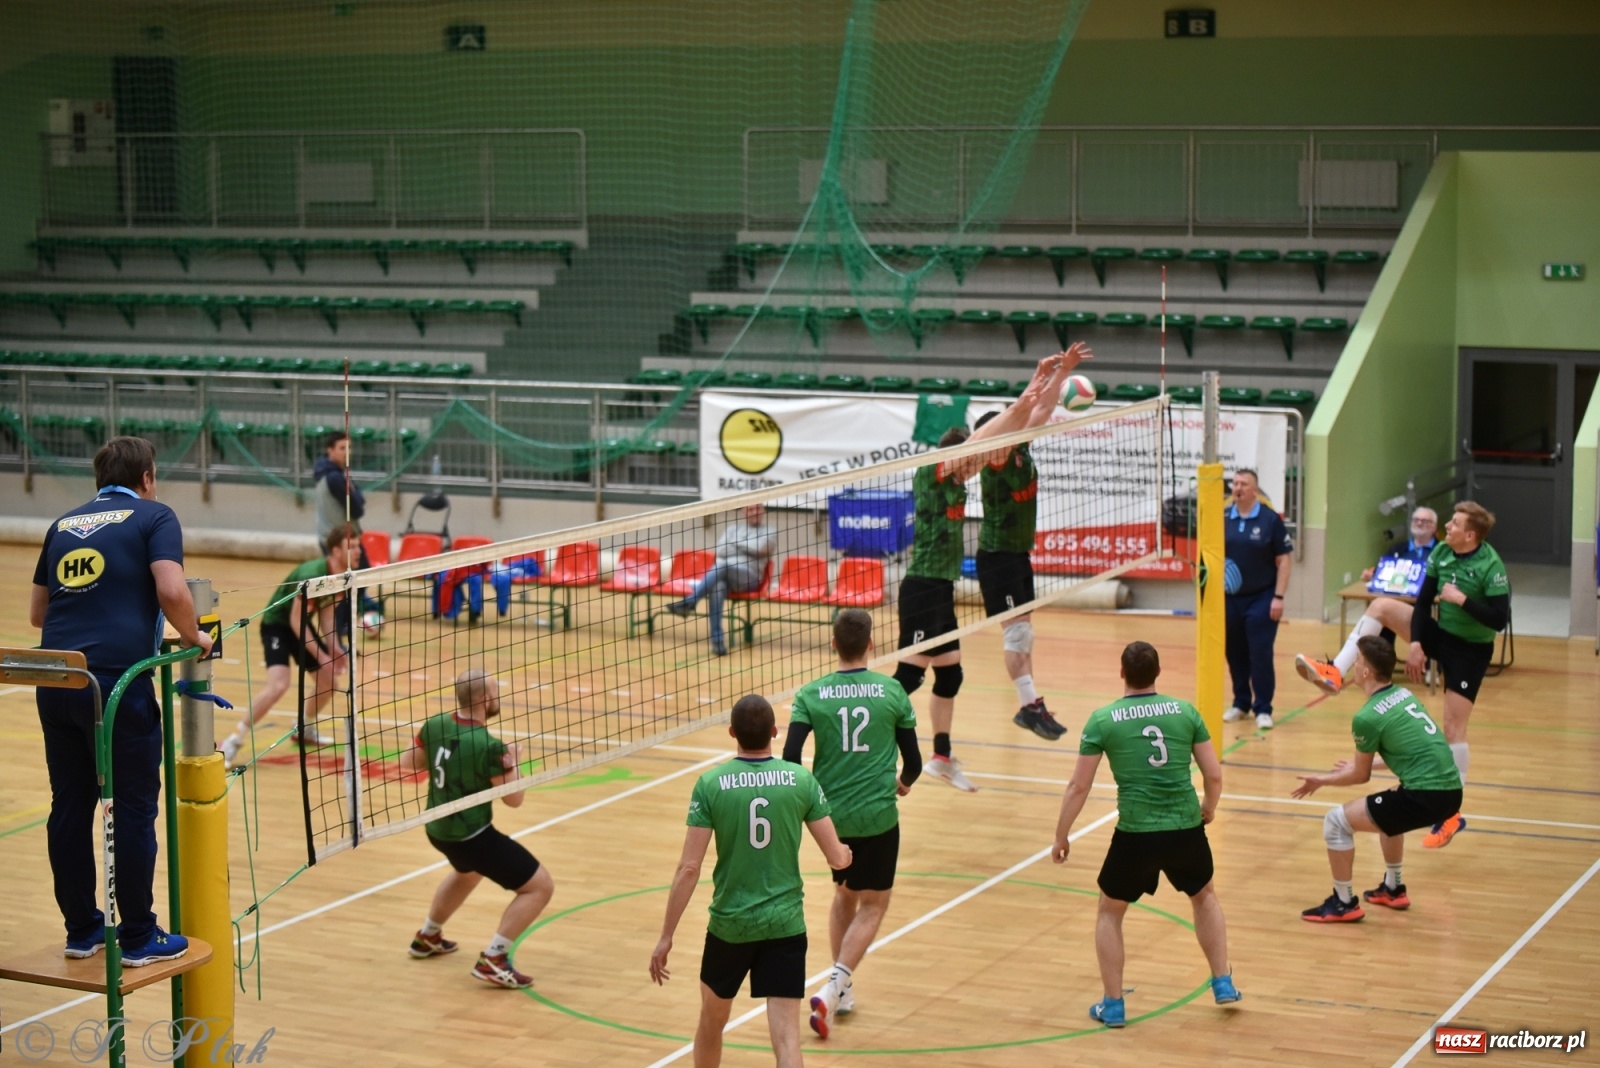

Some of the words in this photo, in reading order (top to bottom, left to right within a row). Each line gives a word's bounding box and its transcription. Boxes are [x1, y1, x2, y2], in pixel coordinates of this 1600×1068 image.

[1188, 19, 1209, 35] B
[846, 454, 865, 472] W
[61, 511, 124, 530] TWINPIGS
[838, 514, 891, 530] molten
[1044, 533, 1078, 551] 695
[64, 555, 97, 580] HK
[819, 683, 886, 700] WŁODOWICE
[1111, 701, 1182, 722] WŁODOWICE
[1404, 702, 1437, 735] 5
[837, 706, 870, 752] 12
[1142, 725, 1168, 767] 3
[434, 746, 451, 789] 5
[719, 770, 797, 791] WŁODOWICE
[749, 797, 771, 849] 6
